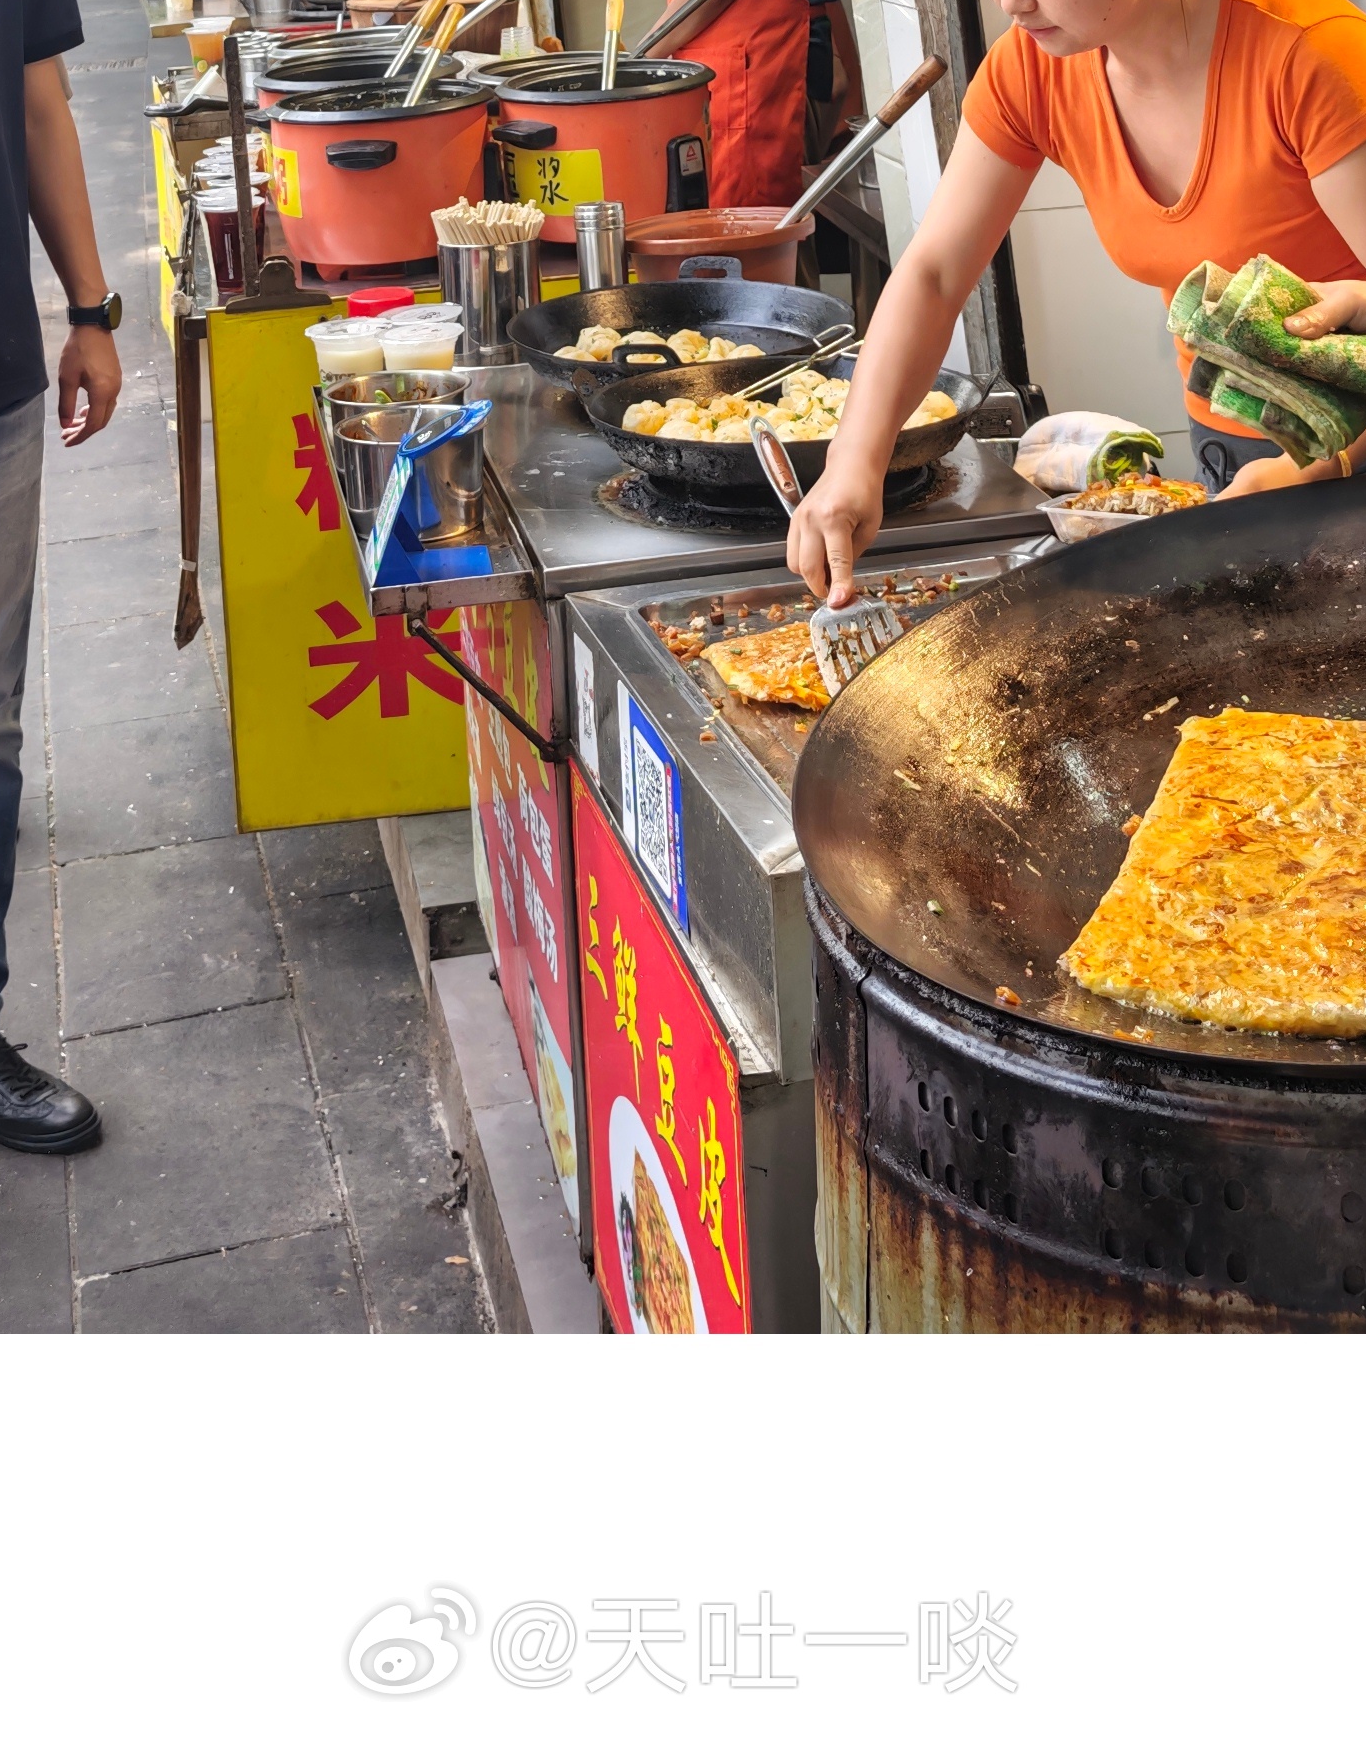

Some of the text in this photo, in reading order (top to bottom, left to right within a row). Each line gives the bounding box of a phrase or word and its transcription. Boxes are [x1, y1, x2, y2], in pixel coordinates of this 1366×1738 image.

[516, 762, 554, 888] 荷包蛋
[521, 852, 559, 984] 酸梅汤
[584, 872, 742, 1308] 三鲜豆皮
